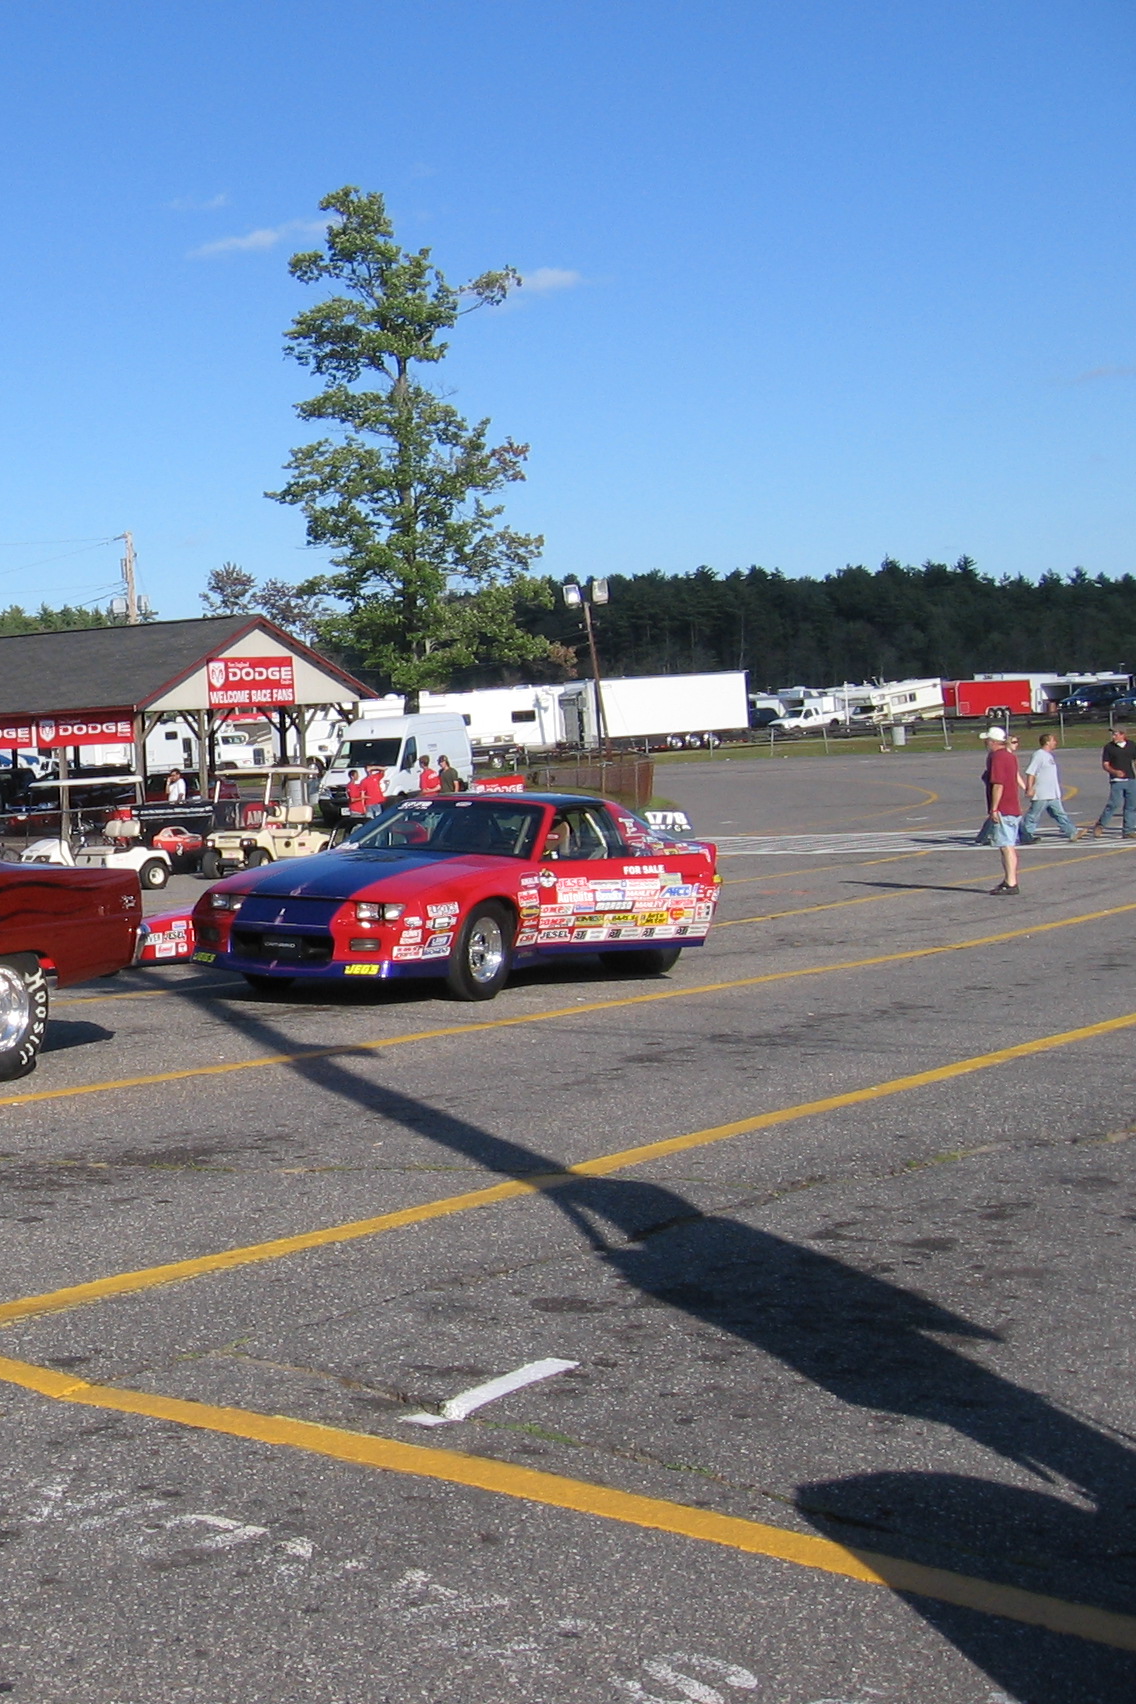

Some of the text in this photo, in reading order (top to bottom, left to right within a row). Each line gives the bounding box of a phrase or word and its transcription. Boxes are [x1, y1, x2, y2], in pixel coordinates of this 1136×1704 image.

[228, 667, 292, 681] DODGE
[210, 688, 293, 704] WELCOME RACE FANS
[58, 721, 131, 737] DODGE
[623, 865, 665, 875] FOR SALE
[558, 879, 587, 888] JESEL
[540, 930, 569, 939] JESEL
[397, 1356, 581, 1427] 1
